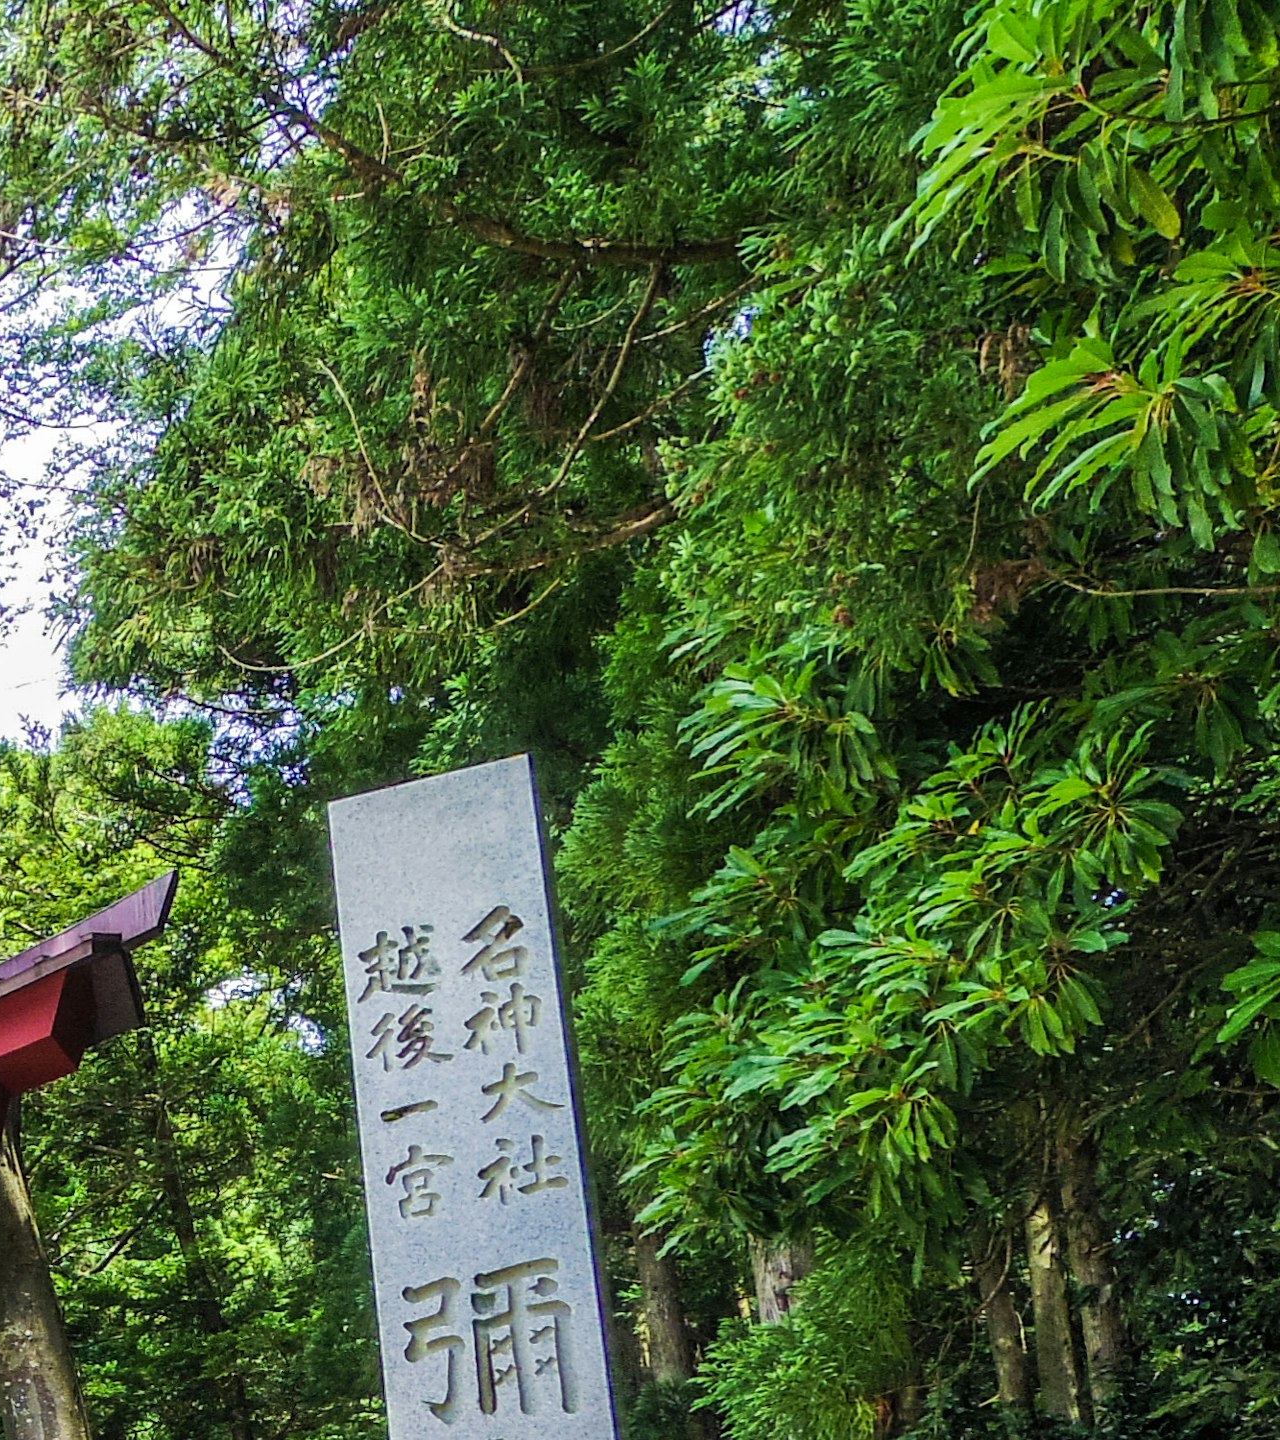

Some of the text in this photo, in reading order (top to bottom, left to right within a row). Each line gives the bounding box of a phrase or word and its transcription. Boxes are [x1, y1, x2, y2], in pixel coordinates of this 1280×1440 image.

[357, 924, 454, 1219] 越後一宮
[460, 904, 568, 1206] 名神大社
